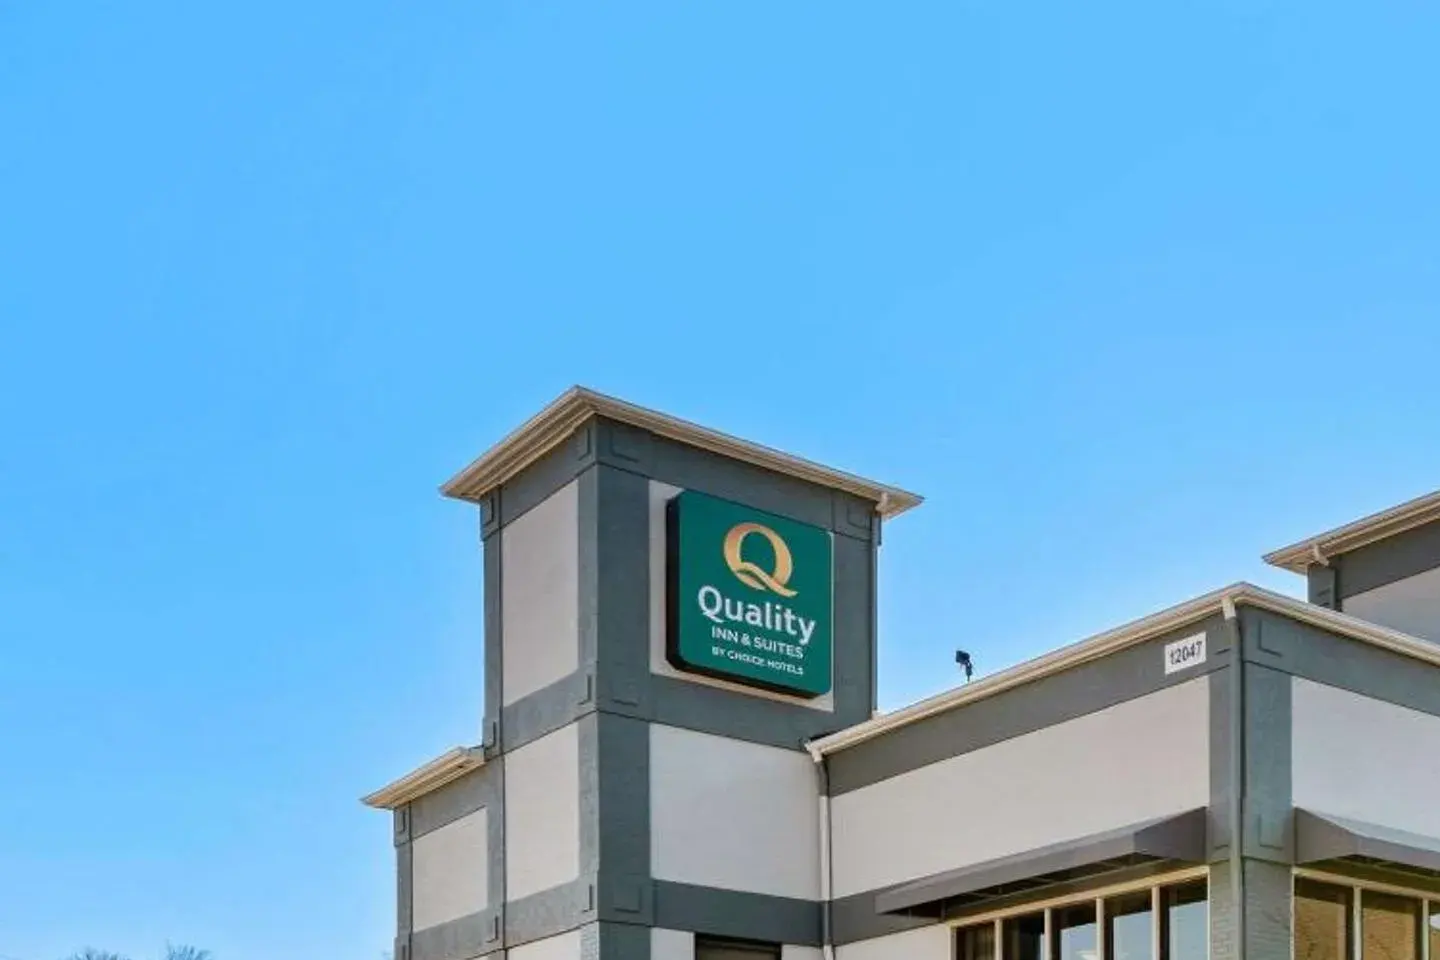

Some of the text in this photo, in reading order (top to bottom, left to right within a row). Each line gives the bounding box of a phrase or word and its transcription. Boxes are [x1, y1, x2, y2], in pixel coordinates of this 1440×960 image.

[698, 585, 816, 645] Quality
[712, 625, 803, 659] INN & SUITES
[1170, 640, 1203, 665] 12047
[712, 645, 804, 676] BY CHOICE HOTELS
